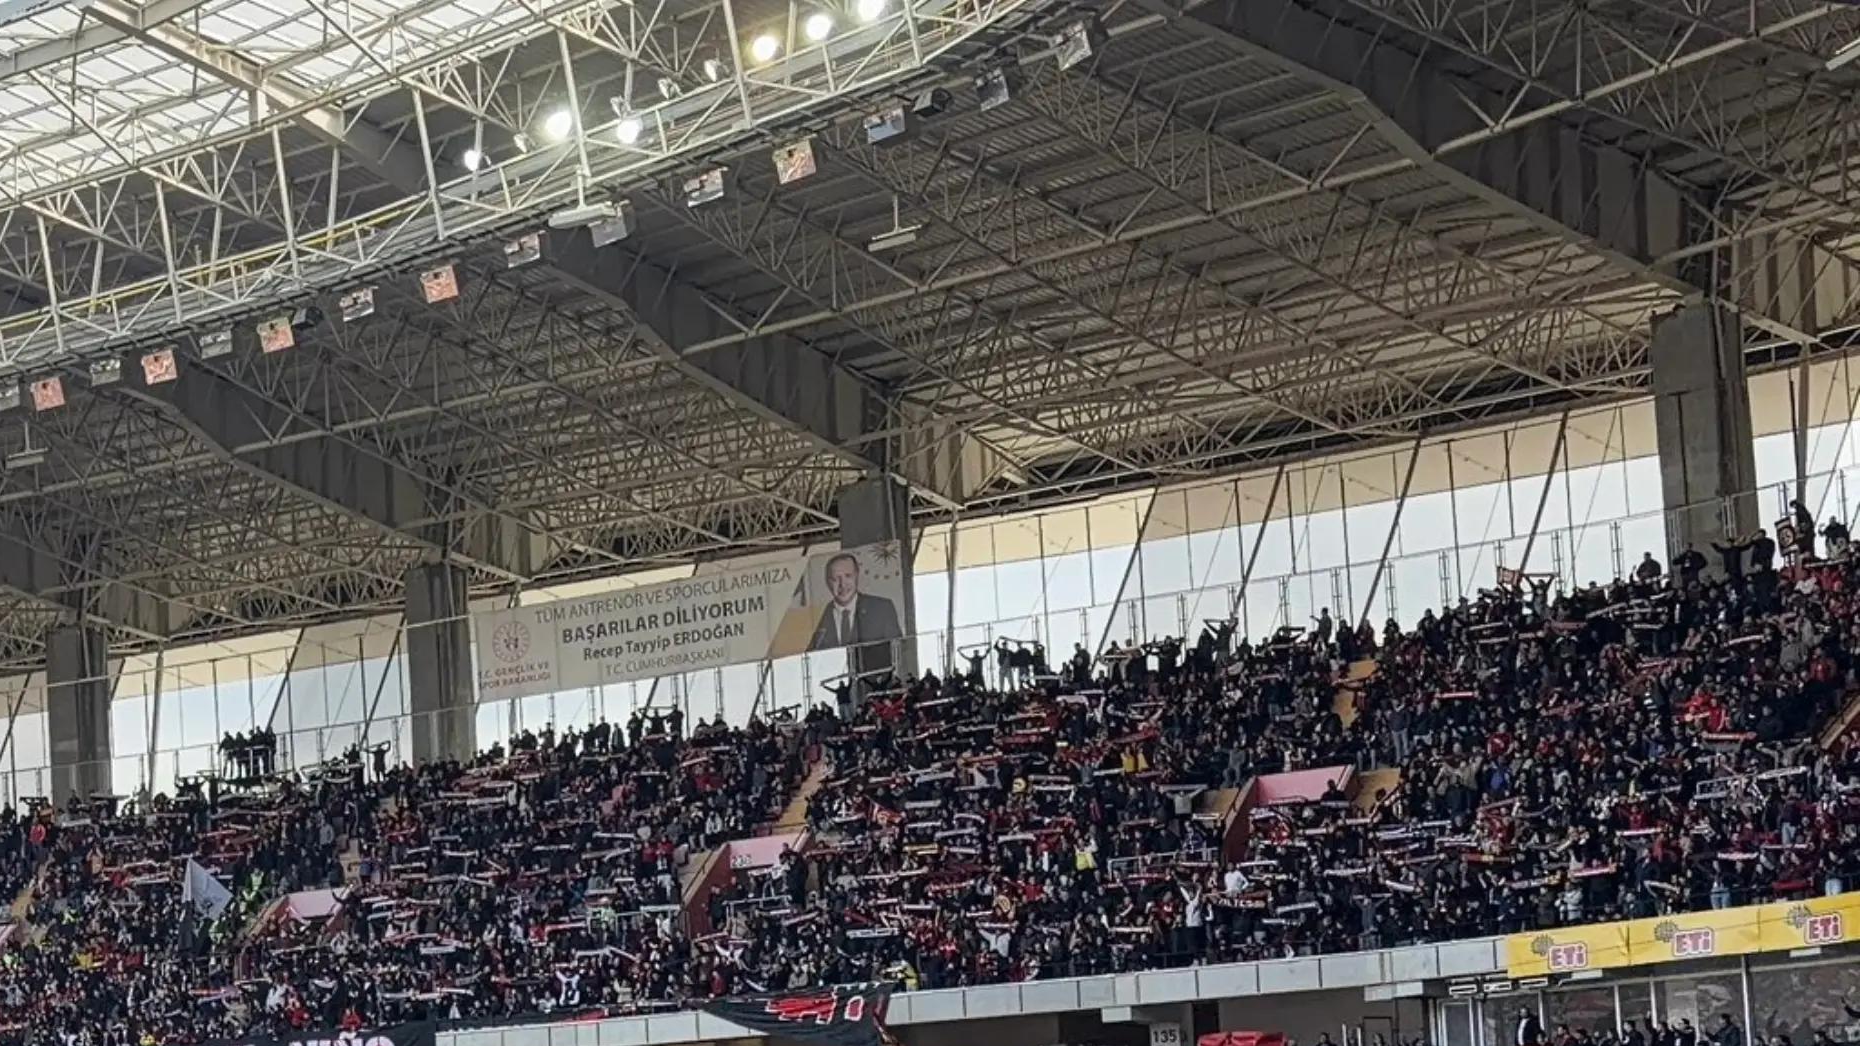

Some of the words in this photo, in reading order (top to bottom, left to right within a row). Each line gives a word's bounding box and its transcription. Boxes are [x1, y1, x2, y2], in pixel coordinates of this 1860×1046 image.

[562, 614, 659, 644] BAŞARILAR
[663, 596, 765, 628] DİLİYORUM
[583, 644, 623, 661] Recep
[625, 635, 671, 654] Tayyip
[673, 622, 745, 646] ERDOĞAN
[1153, 1029, 1177, 1043] 135
